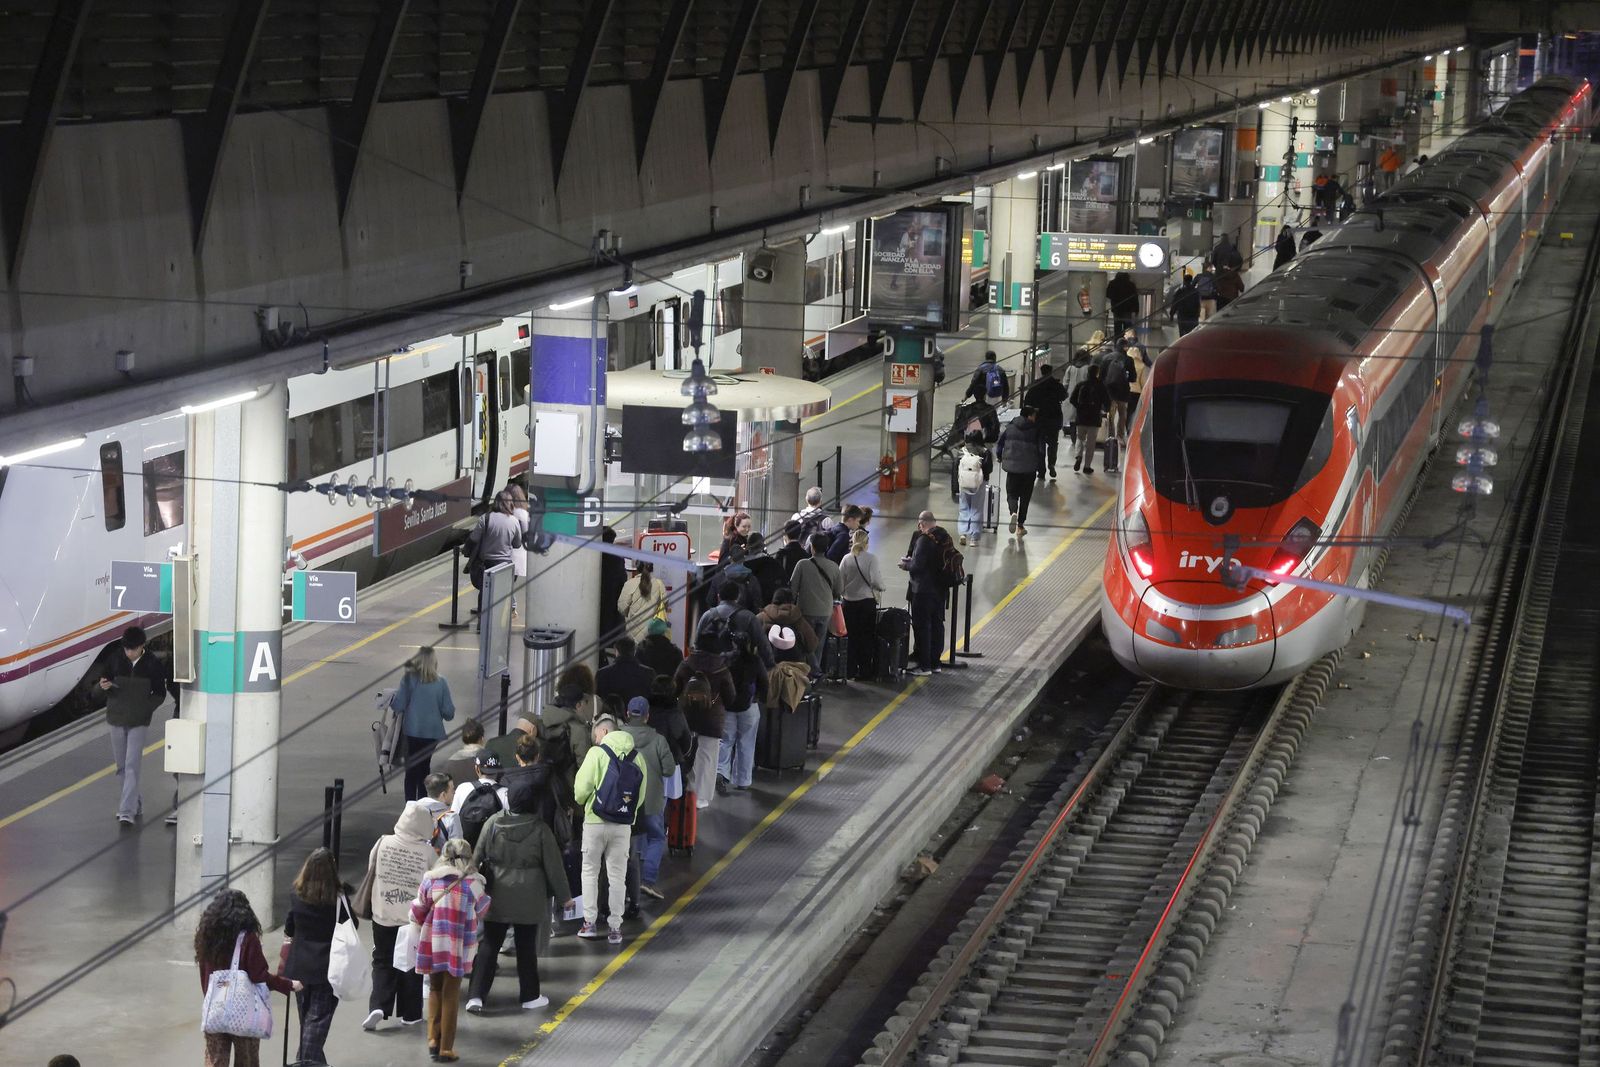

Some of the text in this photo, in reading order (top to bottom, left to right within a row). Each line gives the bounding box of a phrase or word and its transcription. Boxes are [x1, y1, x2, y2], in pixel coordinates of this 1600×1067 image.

[1307, 154, 1314, 166] K
[1051, 252, 1061, 266] 6
[989, 285, 997, 304] E
[1021, 287, 1031, 306] E
[884, 335, 895, 356] D
[924, 337, 935, 358] D
[404, 501, 447, 530] Sevilla Santa Justa
[583, 497, 601, 527] B
[653, 539, 677, 554] iryo
[114, 585, 127, 607] 7
[338, 596, 352, 619] 6
[248, 641, 277, 682] A
